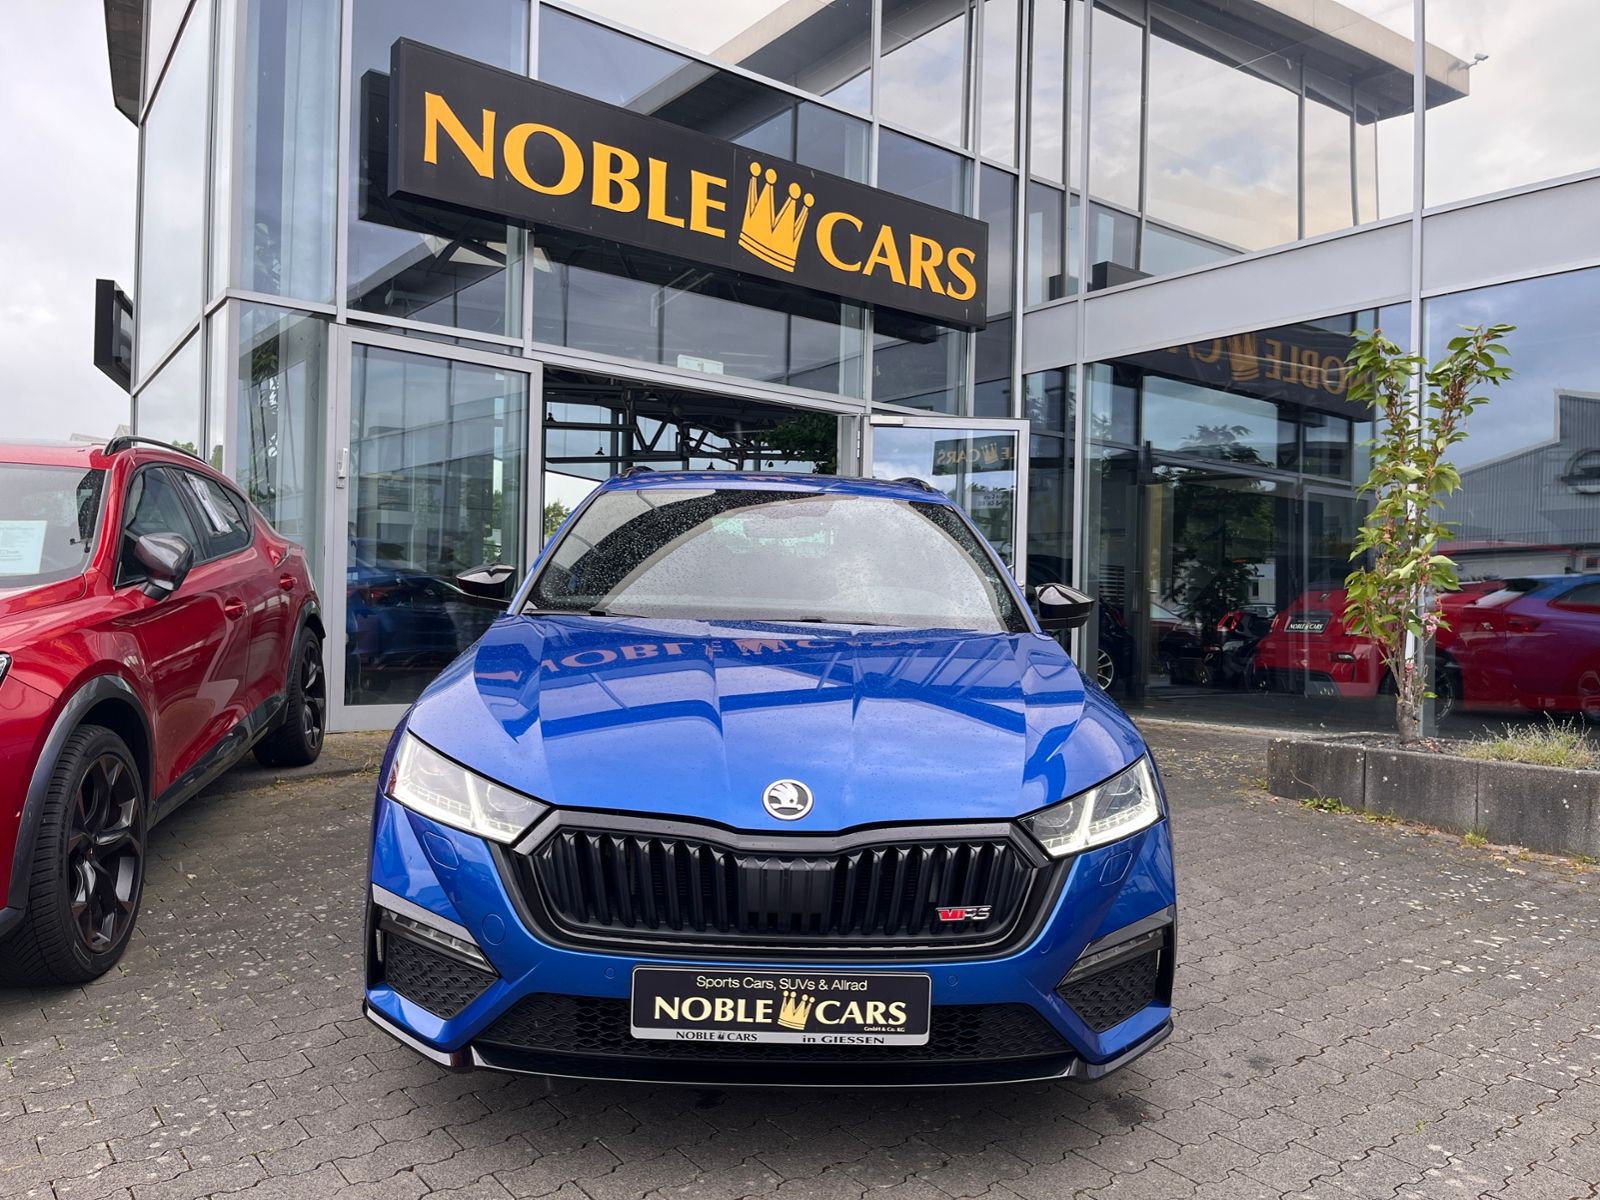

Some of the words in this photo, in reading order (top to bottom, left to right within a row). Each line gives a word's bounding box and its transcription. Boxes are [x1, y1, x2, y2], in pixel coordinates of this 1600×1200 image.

[423, 91, 728, 239] NOBLE
[816, 211, 978, 301] CARS
[696, 975, 740, 989] Sports
[743, 977, 776, 990] Cars,
[779, 978, 816, 991] SUVs
[818, 979, 828, 991] &
[831, 979, 868, 991] Allrad
[654, 996, 773, 1023] NOBLE
[815, 1000, 907, 1025] CARS
[676, 1031, 716, 1040] NOBLE
[727, 1032, 757, 1041] CARS
[802, 1034, 816, 1043] in
[821, 1035, 884, 1044] GIESSEN
